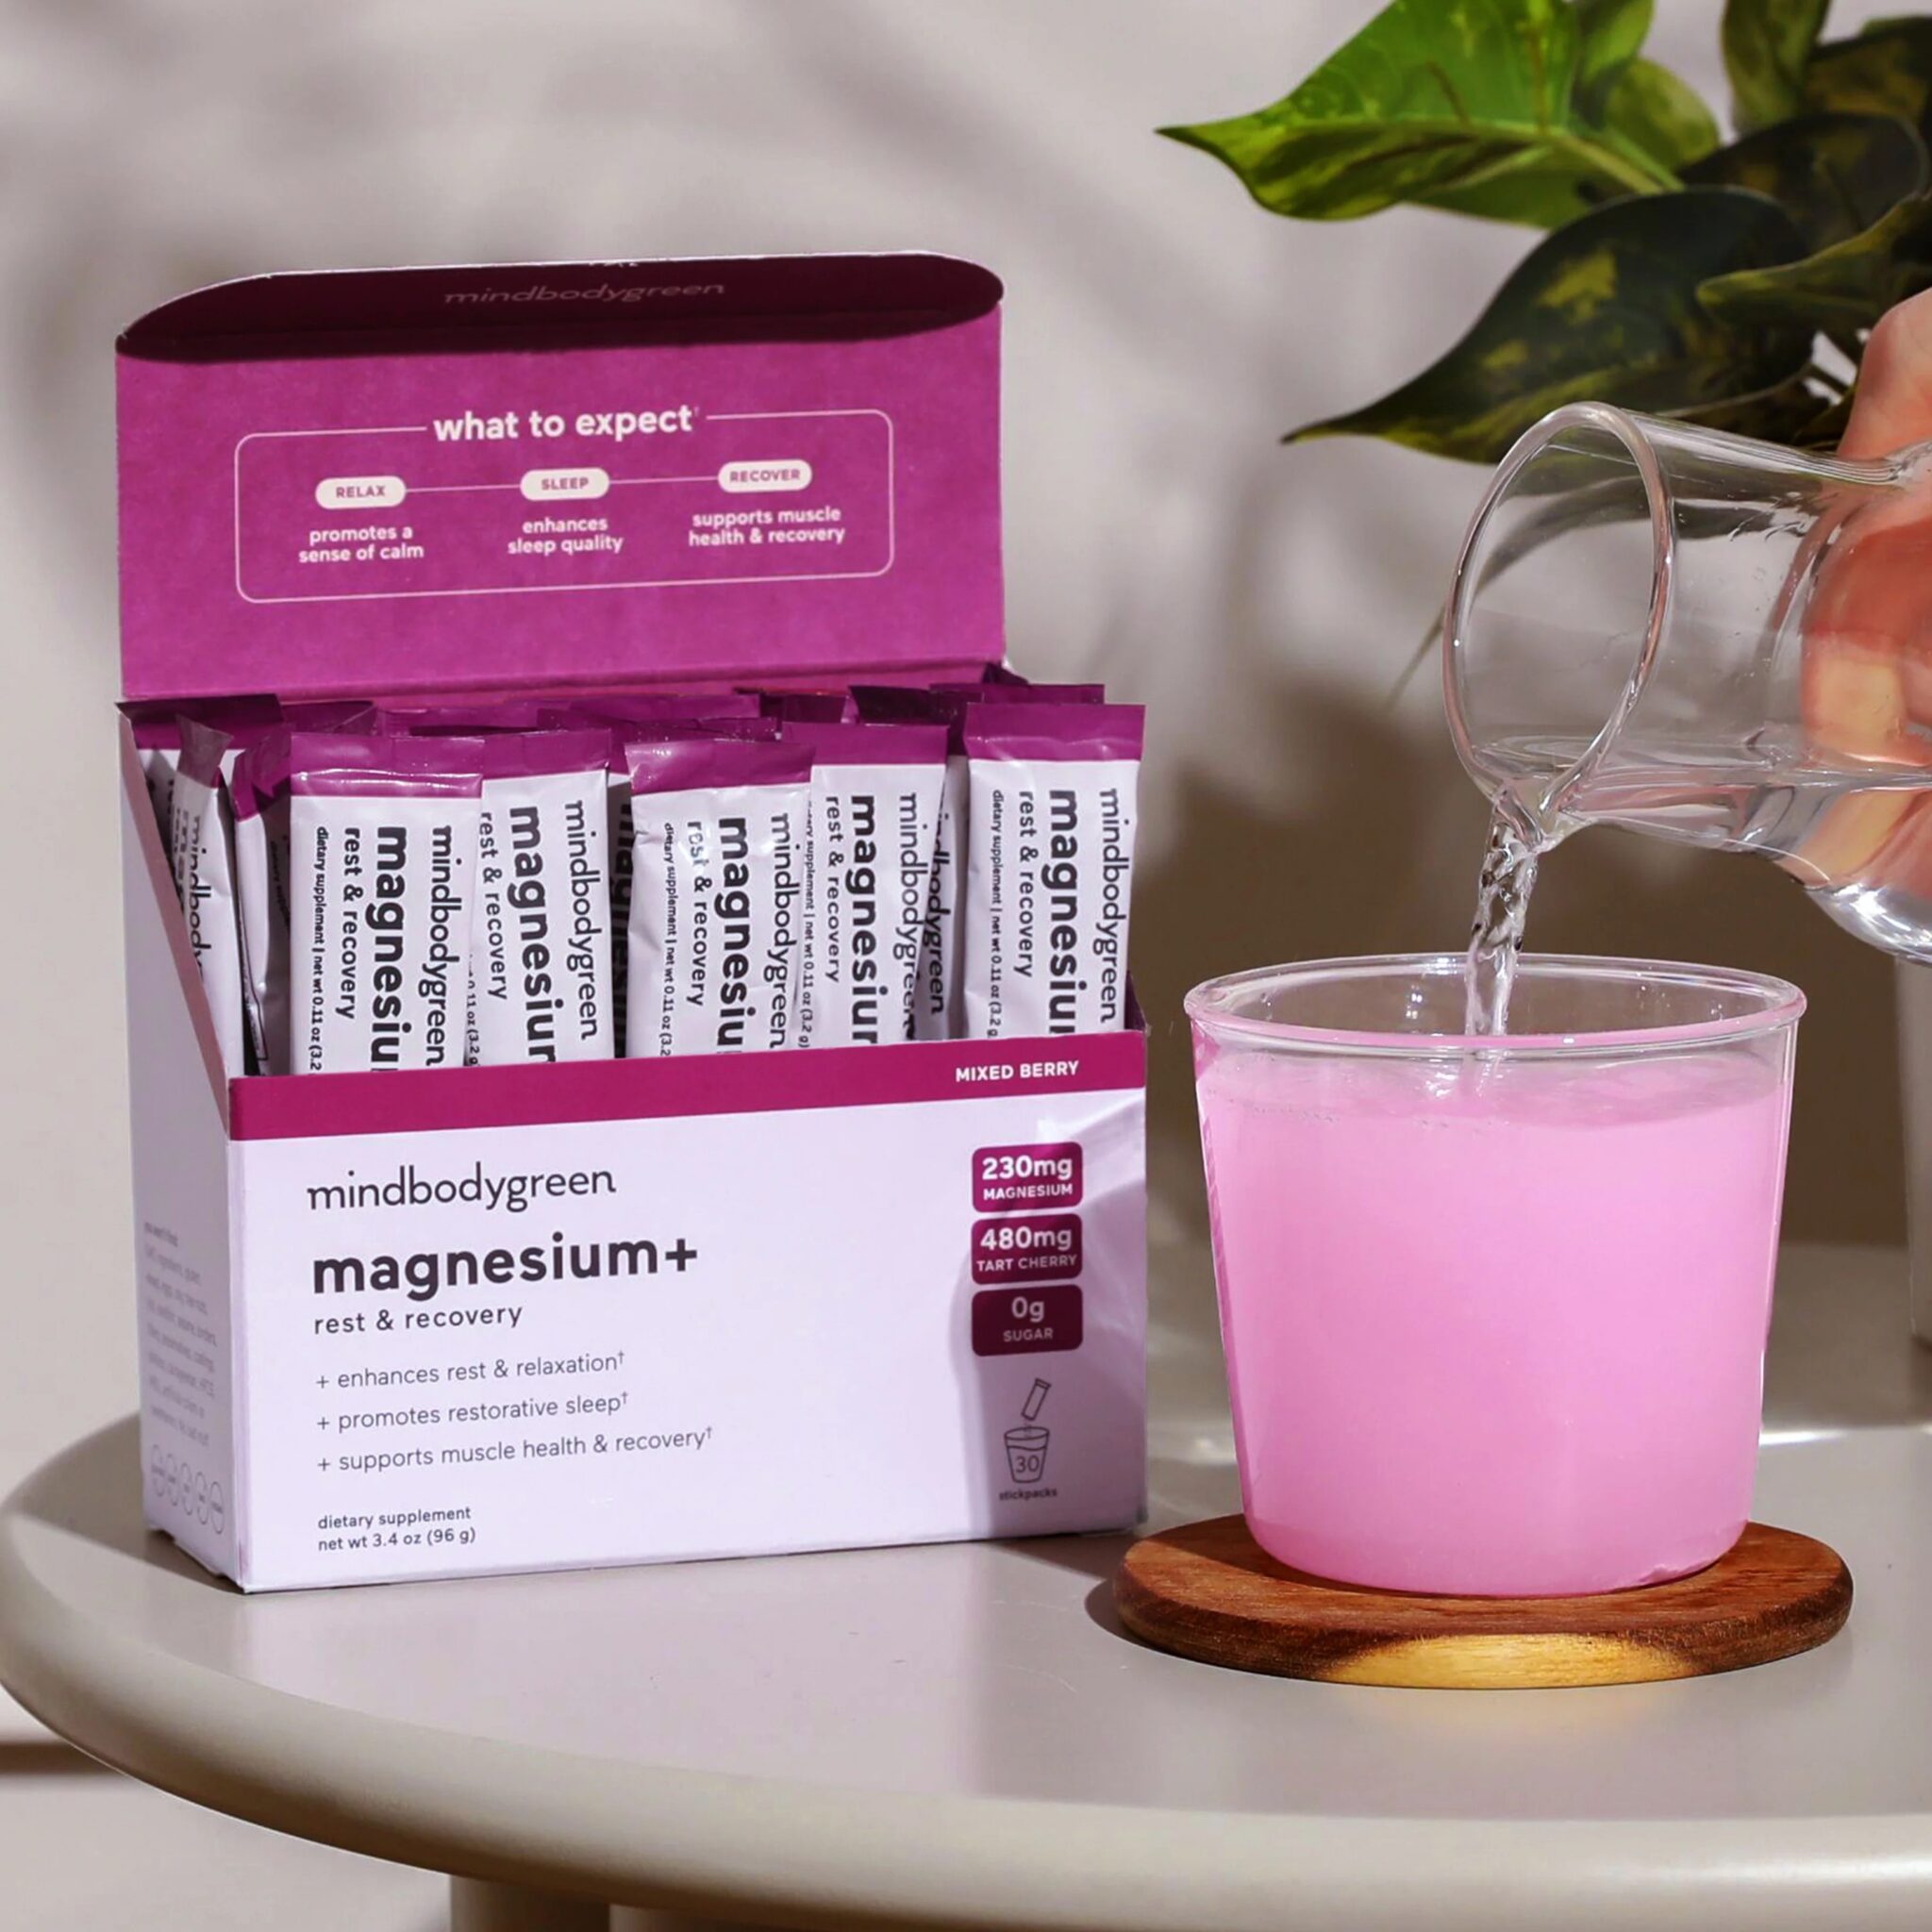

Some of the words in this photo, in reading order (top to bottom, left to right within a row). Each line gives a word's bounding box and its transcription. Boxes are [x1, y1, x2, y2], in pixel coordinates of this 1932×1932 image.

[444, 283, 724, 304] mindbodygreen
[433, 410, 519, 441] what
[528, 410, 565, 438] to
[541, 476, 590, 491] SLEEP
[729, 468, 801, 483] RECOVER
[335, 485, 386, 499] RELAX
[522, 517, 608, 534] enhances
[693, 511, 772, 528] supports
[777, 506, 841, 523] muscle
[310, 526, 398, 545] promotes
[402, 526, 413, 540] a
[508, 538, 557, 556] sleep
[560, 533, 623, 555] quality
[690, 525, 743, 544] health
[749, 527, 762, 543] &
[768, 528, 845, 544] recovery
[299, 549, 351, 563] sense
[356, 543, 375, 560] of
[379, 542, 425, 559] calm
[825, 796, 844, 842] rest
[991, 790, 1004, 833] dietary
[1019, 791, 1038, 838] rest
[478, 811, 499, 859] rest
[663, 822, 675, 863] dietary
[687, 821, 710, 867] rest
[313, 825, 329, 872] dietary
[343, 827, 363, 876] rest
[828, 851, 844, 867] &
[1020, 845, 1040, 862] &
[482, 867, 503, 884] &
[804, 840, 816, 909] supplement
[991, 835, 1003, 904] supplement
[342, 884, 364, 902] &
[693, 875, 713, 892] &
[312, 873, 327, 944] supplement
[665, 866, 678, 936] supplement
[1041, 791, 1087, 1034] magnesiu
[1093, 789, 1129, 1024] mindbodygreen
[565, 801, 602, 1040] mindbodygreen
[764, 813, 800, 1049] mindbodygreen
[805, 921, 814, 941] net
[824, 876, 840, 983] recovery
[991, 916, 1001, 934] net
[1013, 872, 1034, 977] recovery
[418, 825, 462, 1066] mindbodygreen
[486, 892, 508, 999] recovery
[714, 817, 757, 1053] magnesiu
[991, 938, 1001, 953] wt
[366, 826, 411, 1072] magnesiu
[665, 946, 675, 966] net
[686, 901, 708, 1007] recovery
[804, 943, 813, 958] wt
[313, 956, 324, 975] net
[335, 910, 358, 1020] recovery
[664, 967, 675, 983] wt
[802, 961, 815, 989] 0.11
[991, 955, 1002, 982] 0.11
[312, 977, 324, 993] wt
[991, 984, 1000, 999] oz
[311, 996, 325, 1024] 0.11
[662, 985, 675, 1013] 0.11
[802, 991, 811, 1006] oz
[465, 1008, 477, 1027] oz
[661, 1015, 671, 1030] oz
[310, 1026, 321, 1042] oz
[988, 1028, 998, 1038] g
[956, 1064, 1014, 1082] MIXED
[1020, 1060, 1079, 1078] BERRY
[982, 1155, 1072, 1181] 230mg
[307, 1160, 617, 1213] mindbodygreen
[983, 1183, 1073, 1201] MAGNESIUM
[980, 1225, 1071, 1251] 480mg
[313, 1231, 698, 1302] magnesium+
[975, 1257, 1014, 1272] TART
[1017, 1255, 1077, 1270] CHERRY
[314, 1312, 366, 1335] rest
[375, 1308, 393, 1331] &
[405, 1307, 523, 1329] recovery
[1011, 1296, 1044, 1323] 0g
[1003, 1326, 1054, 1342] SUGAR
[337, 1367, 440, 1389] enhances
[447, 1362, 487, 1381] rest
[493, 1358, 508, 1378] &
[339, 1407, 441, 1434] promotes
[448, 1397, 558, 1423] restorative
[339, 1448, 434, 1474] supports
[441, 1441, 516, 1464] muscle
[523, 1436, 587, 1458] health
[592, 1433, 608, 1454] &
[1016, 1455, 1040, 1474] 30
[317, 1514, 374, 1530] dietary
[378, 1507, 472, 1527] supplement
[318, 1537, 343, 1551] net
[347, 1536, 368, 1549] wt
[373, 1532, 398, 1548] 3.4
[403, 1533, 422, 1545] oz
[426, 1527, 455, 1546] (96
[458, 1526, 476, 1545] g)
